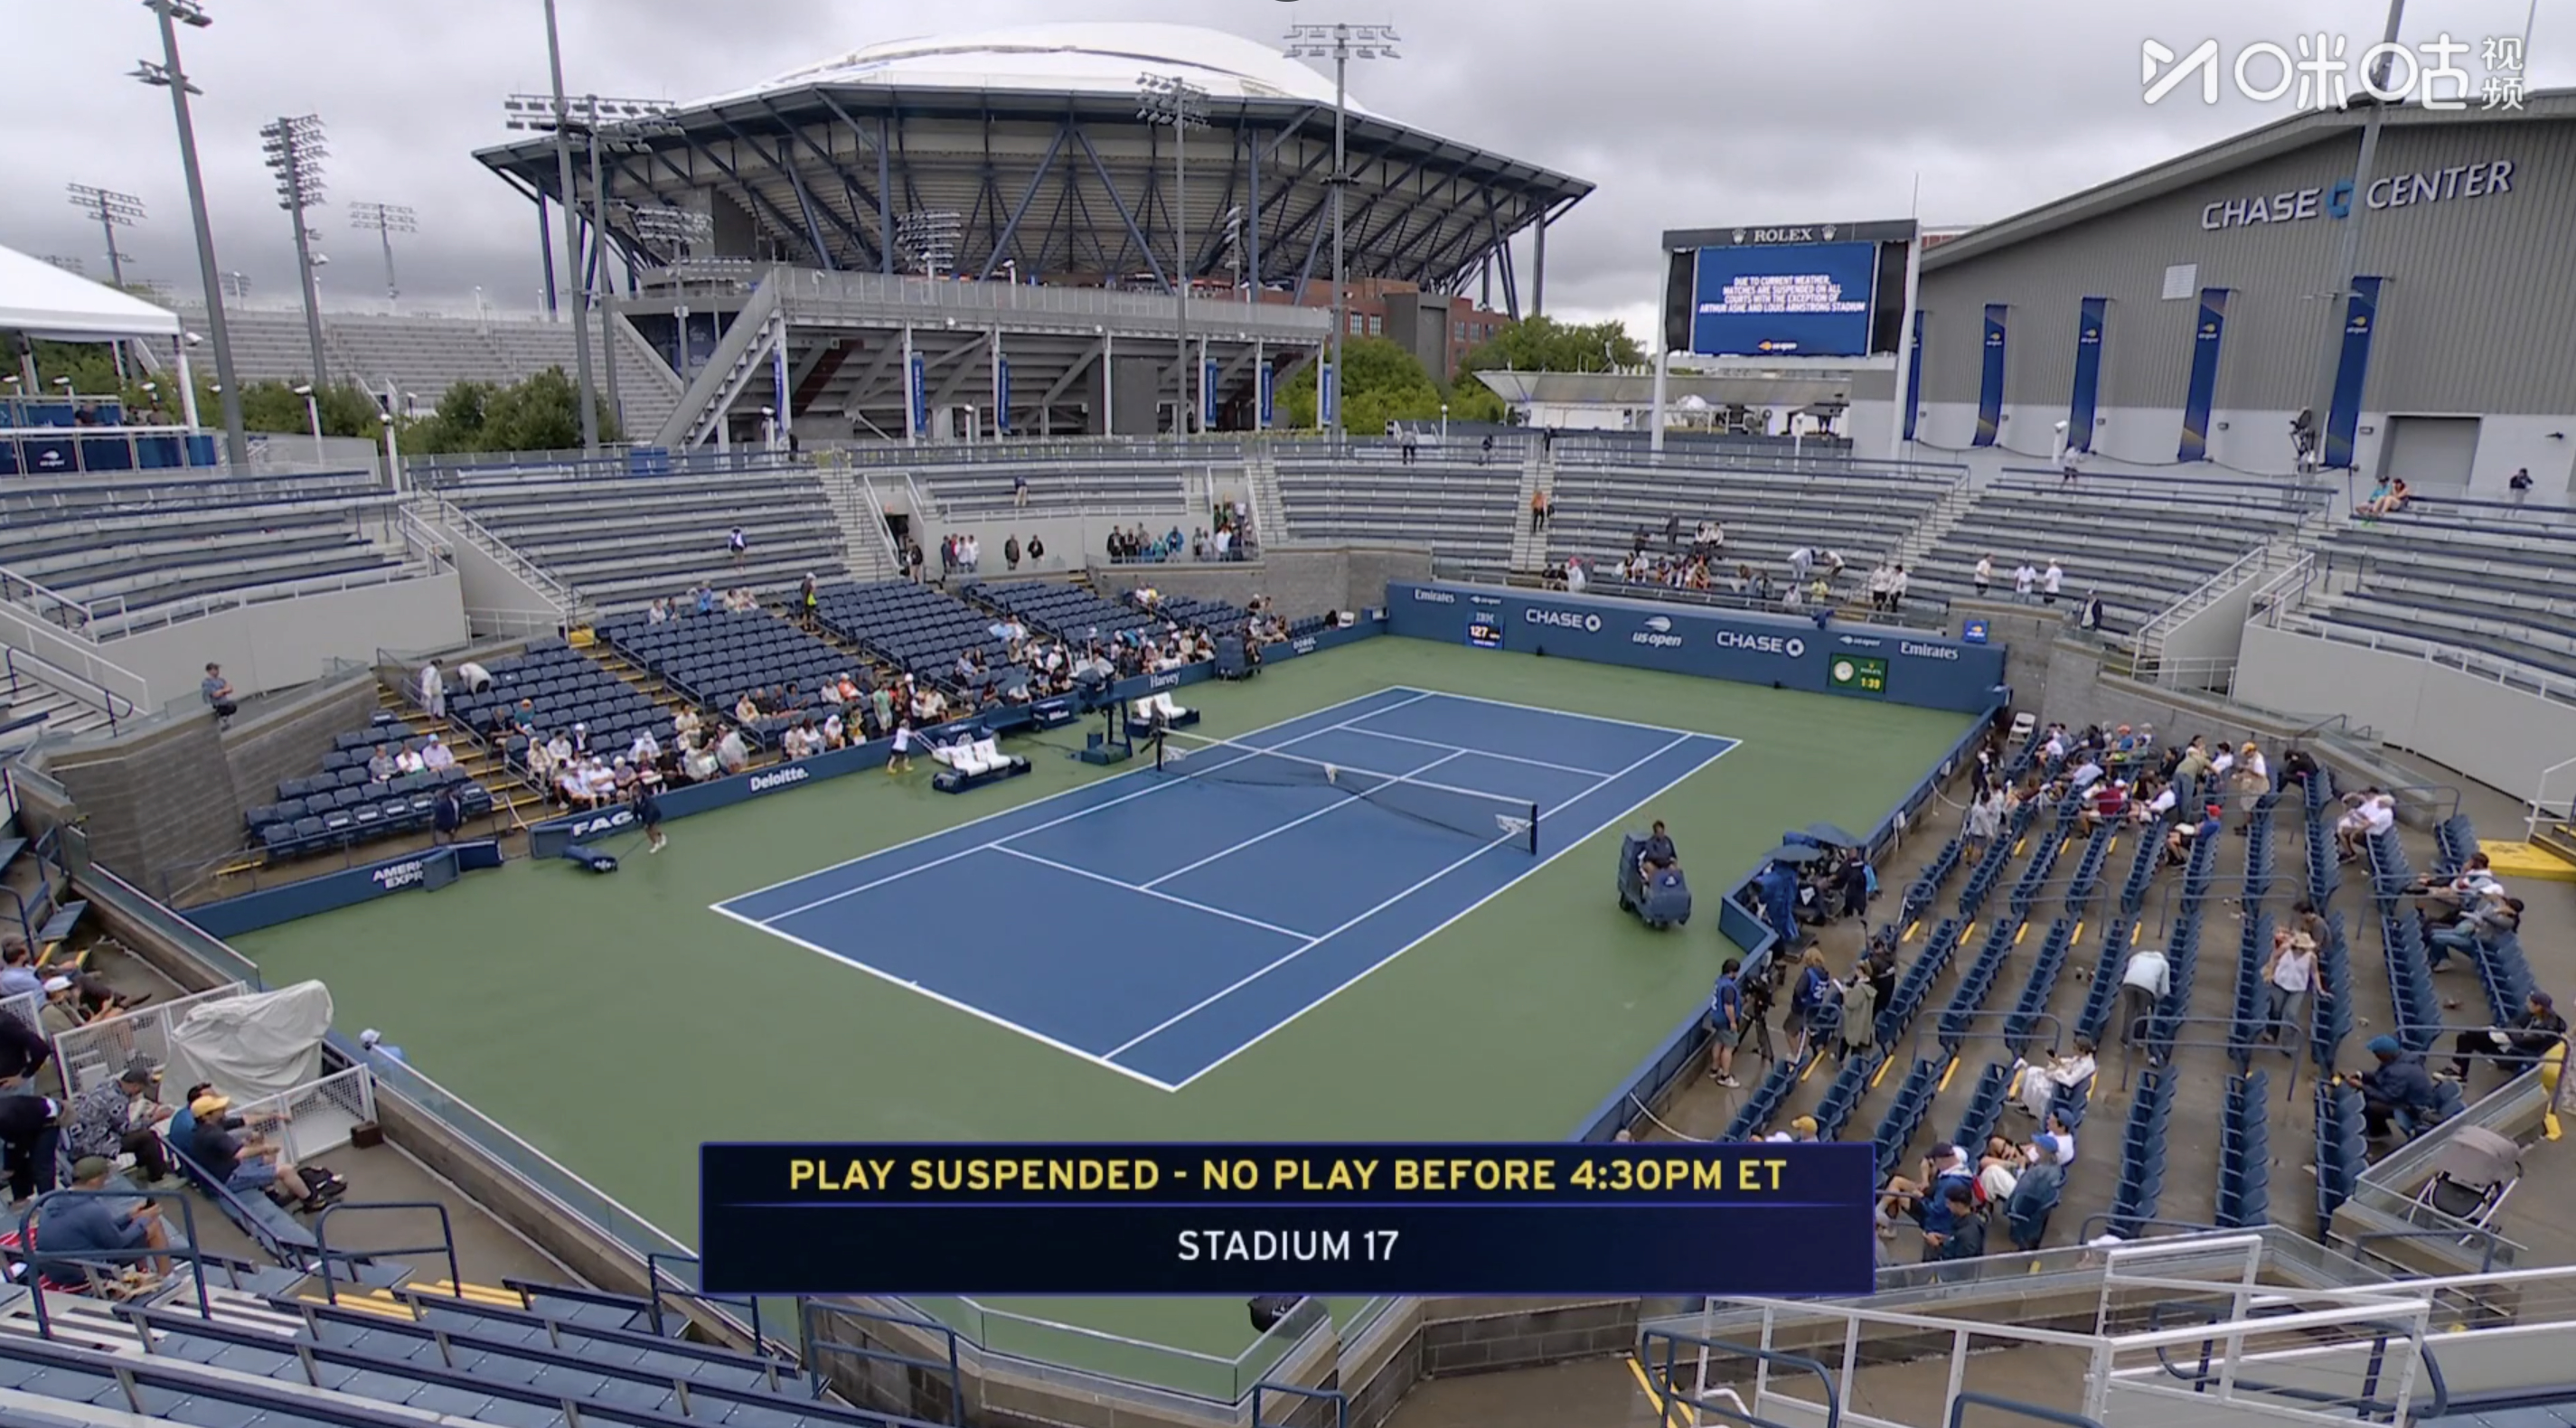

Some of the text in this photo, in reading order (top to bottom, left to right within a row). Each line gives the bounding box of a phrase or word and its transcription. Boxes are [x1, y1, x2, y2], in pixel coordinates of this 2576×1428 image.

[2202, 160, 2515, 230] CHASE CENTER
[1753, 228, 1812, 242] ROLEX
[1750, 277, 1759, 286] TO
[1761, 276, 1793, 285] CURRENT
[1723, 284, 1841, 295] MATCHES ARE SUSPENDED ON ALL
[1725, 295, 1752, 304] COURTS
[1753, 295, 1771, 304] WITH
[1772, 294, 1785, 303] THE
[1787, 293, 1827, 303] EXCEPTION
[1699, 304, 1726, 313] ARTHUR
[1747, 304, 1763, 313] AND
[1764, 303, 1784, 312] LOUIS
[1786, 302, 1829, 312] ARMSTRONG
[1831, 301, 1866, 312] STADIUM
[1415, 589, 1454, 604] Emirates
[1476, 612, 1494, 624] IBM
[1526, 608, 1583, 628] CHASE
[1471, 625, 1488, 638] 127
[1632, 632, 1682, 648] us open
[1717, 631, 1783, 653] CHASE
[1901, 642, 1959, 660] Emirates
[1150, 672, 1180, 689] Harvey
[750, 766, 809, 792] Deloitte.
[573, 811, 634, 837] FAG
[372, 860, 422, 882] AMERI
[385, 870, 424, 889] EXPR
